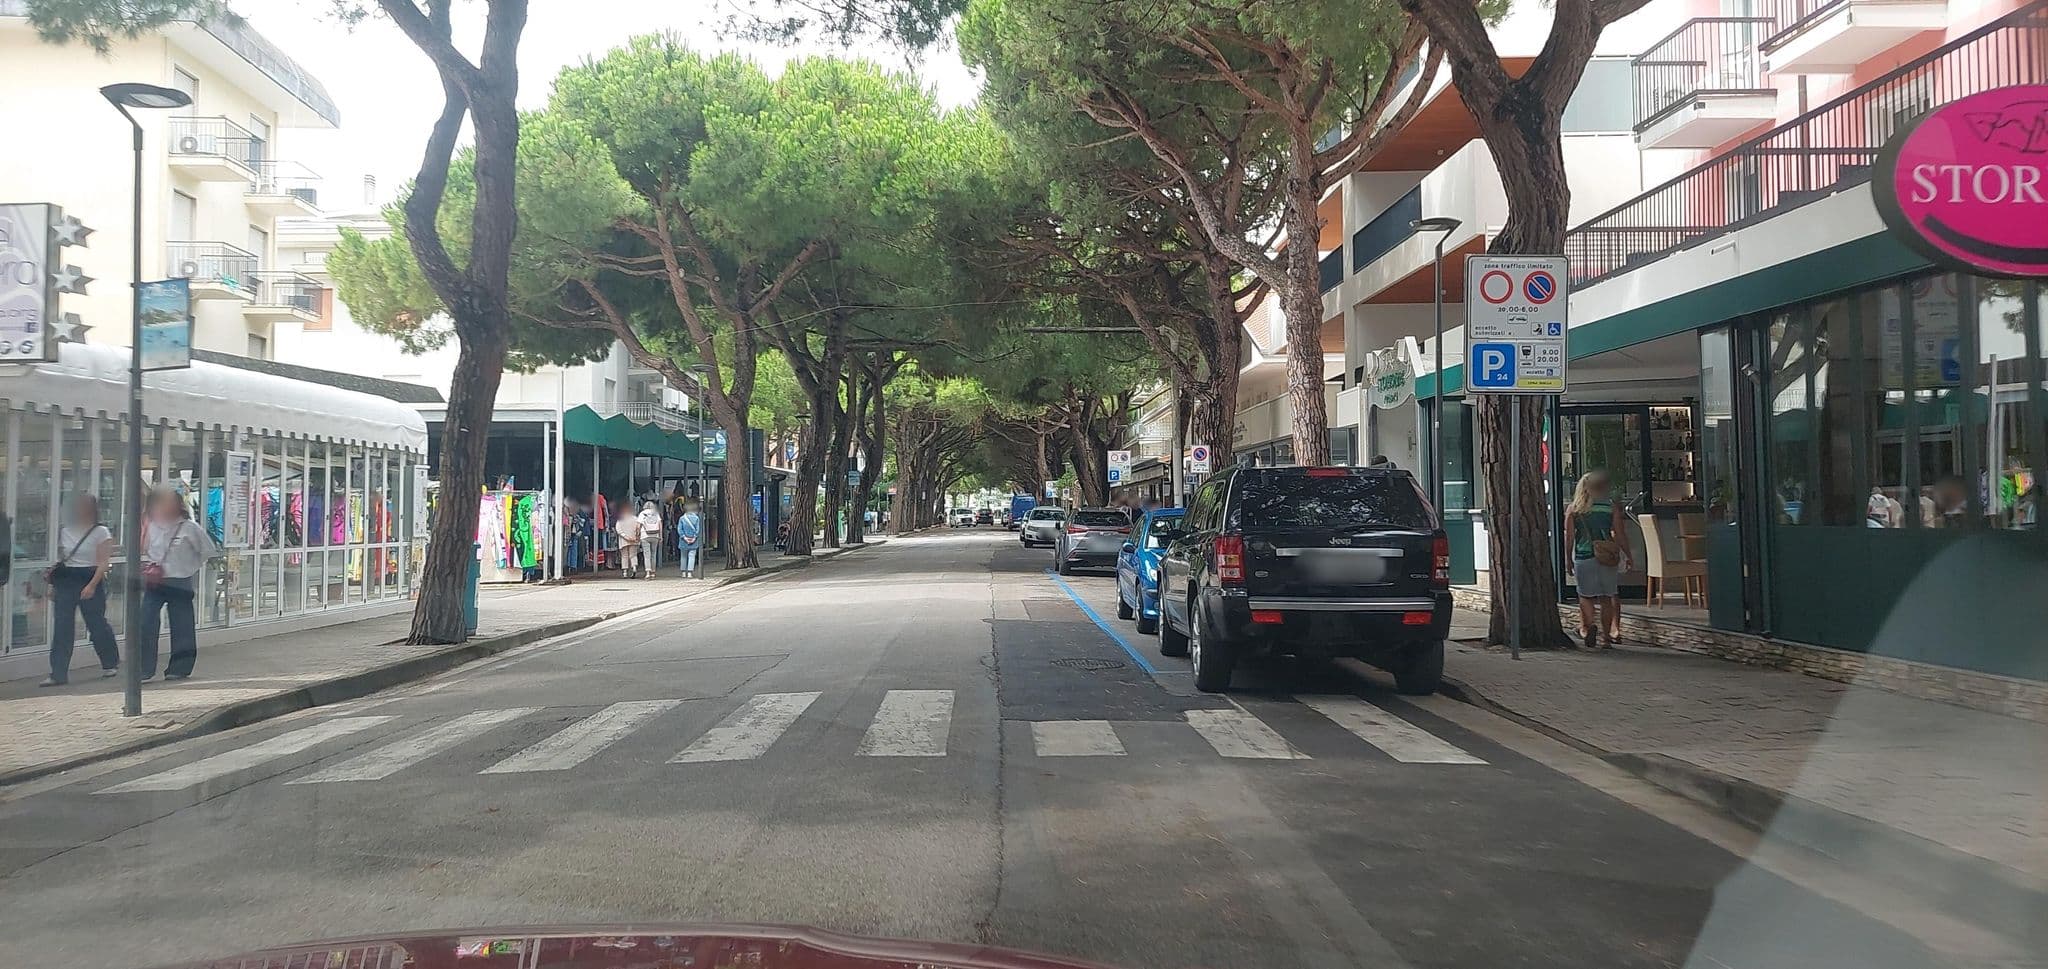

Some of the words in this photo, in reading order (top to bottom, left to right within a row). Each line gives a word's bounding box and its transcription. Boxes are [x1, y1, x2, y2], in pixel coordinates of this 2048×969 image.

[1912, 164, 2048, 204] STOR
[1482, 350, 1505, 380] P
[1328, 537, 1352, 546] Jeep
